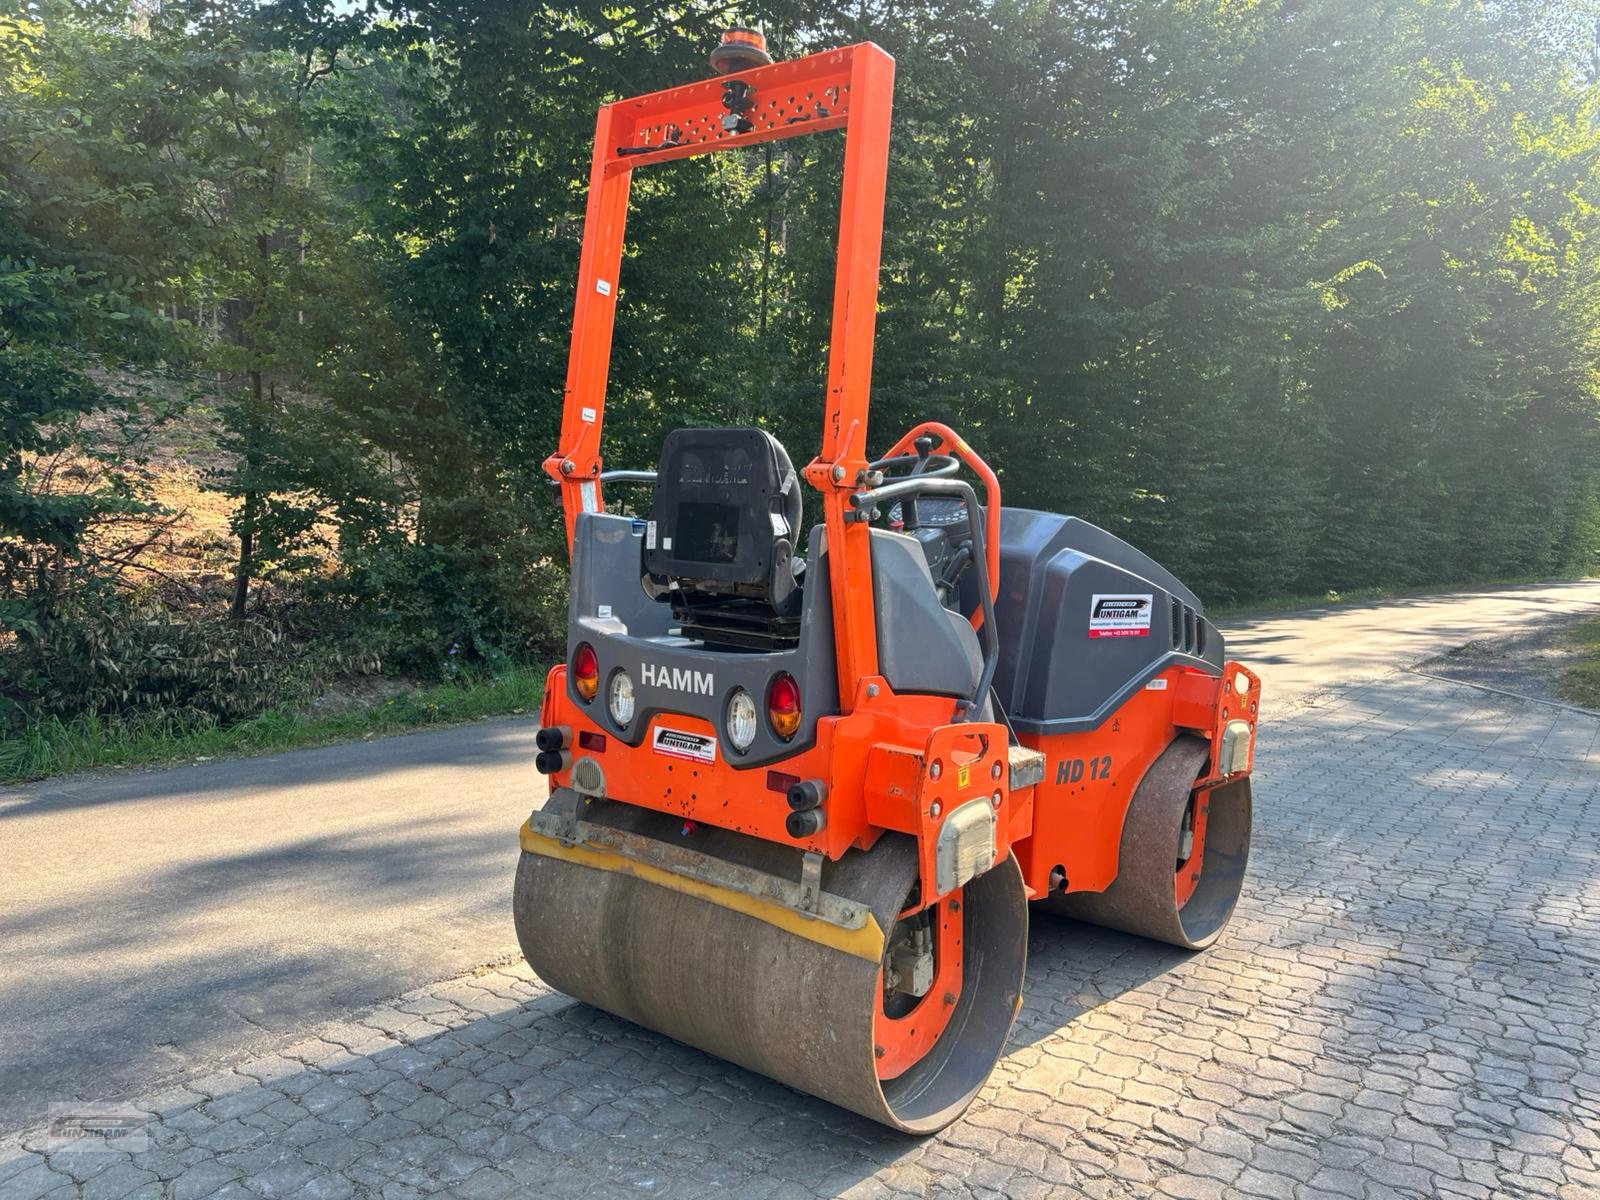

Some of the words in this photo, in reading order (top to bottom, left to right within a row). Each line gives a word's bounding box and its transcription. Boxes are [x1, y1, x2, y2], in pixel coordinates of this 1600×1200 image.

[641, 662, 714, 697] HAMM
[1055, 759, 1085, 785] HD
[1090, 755, 1112, 781] 12
